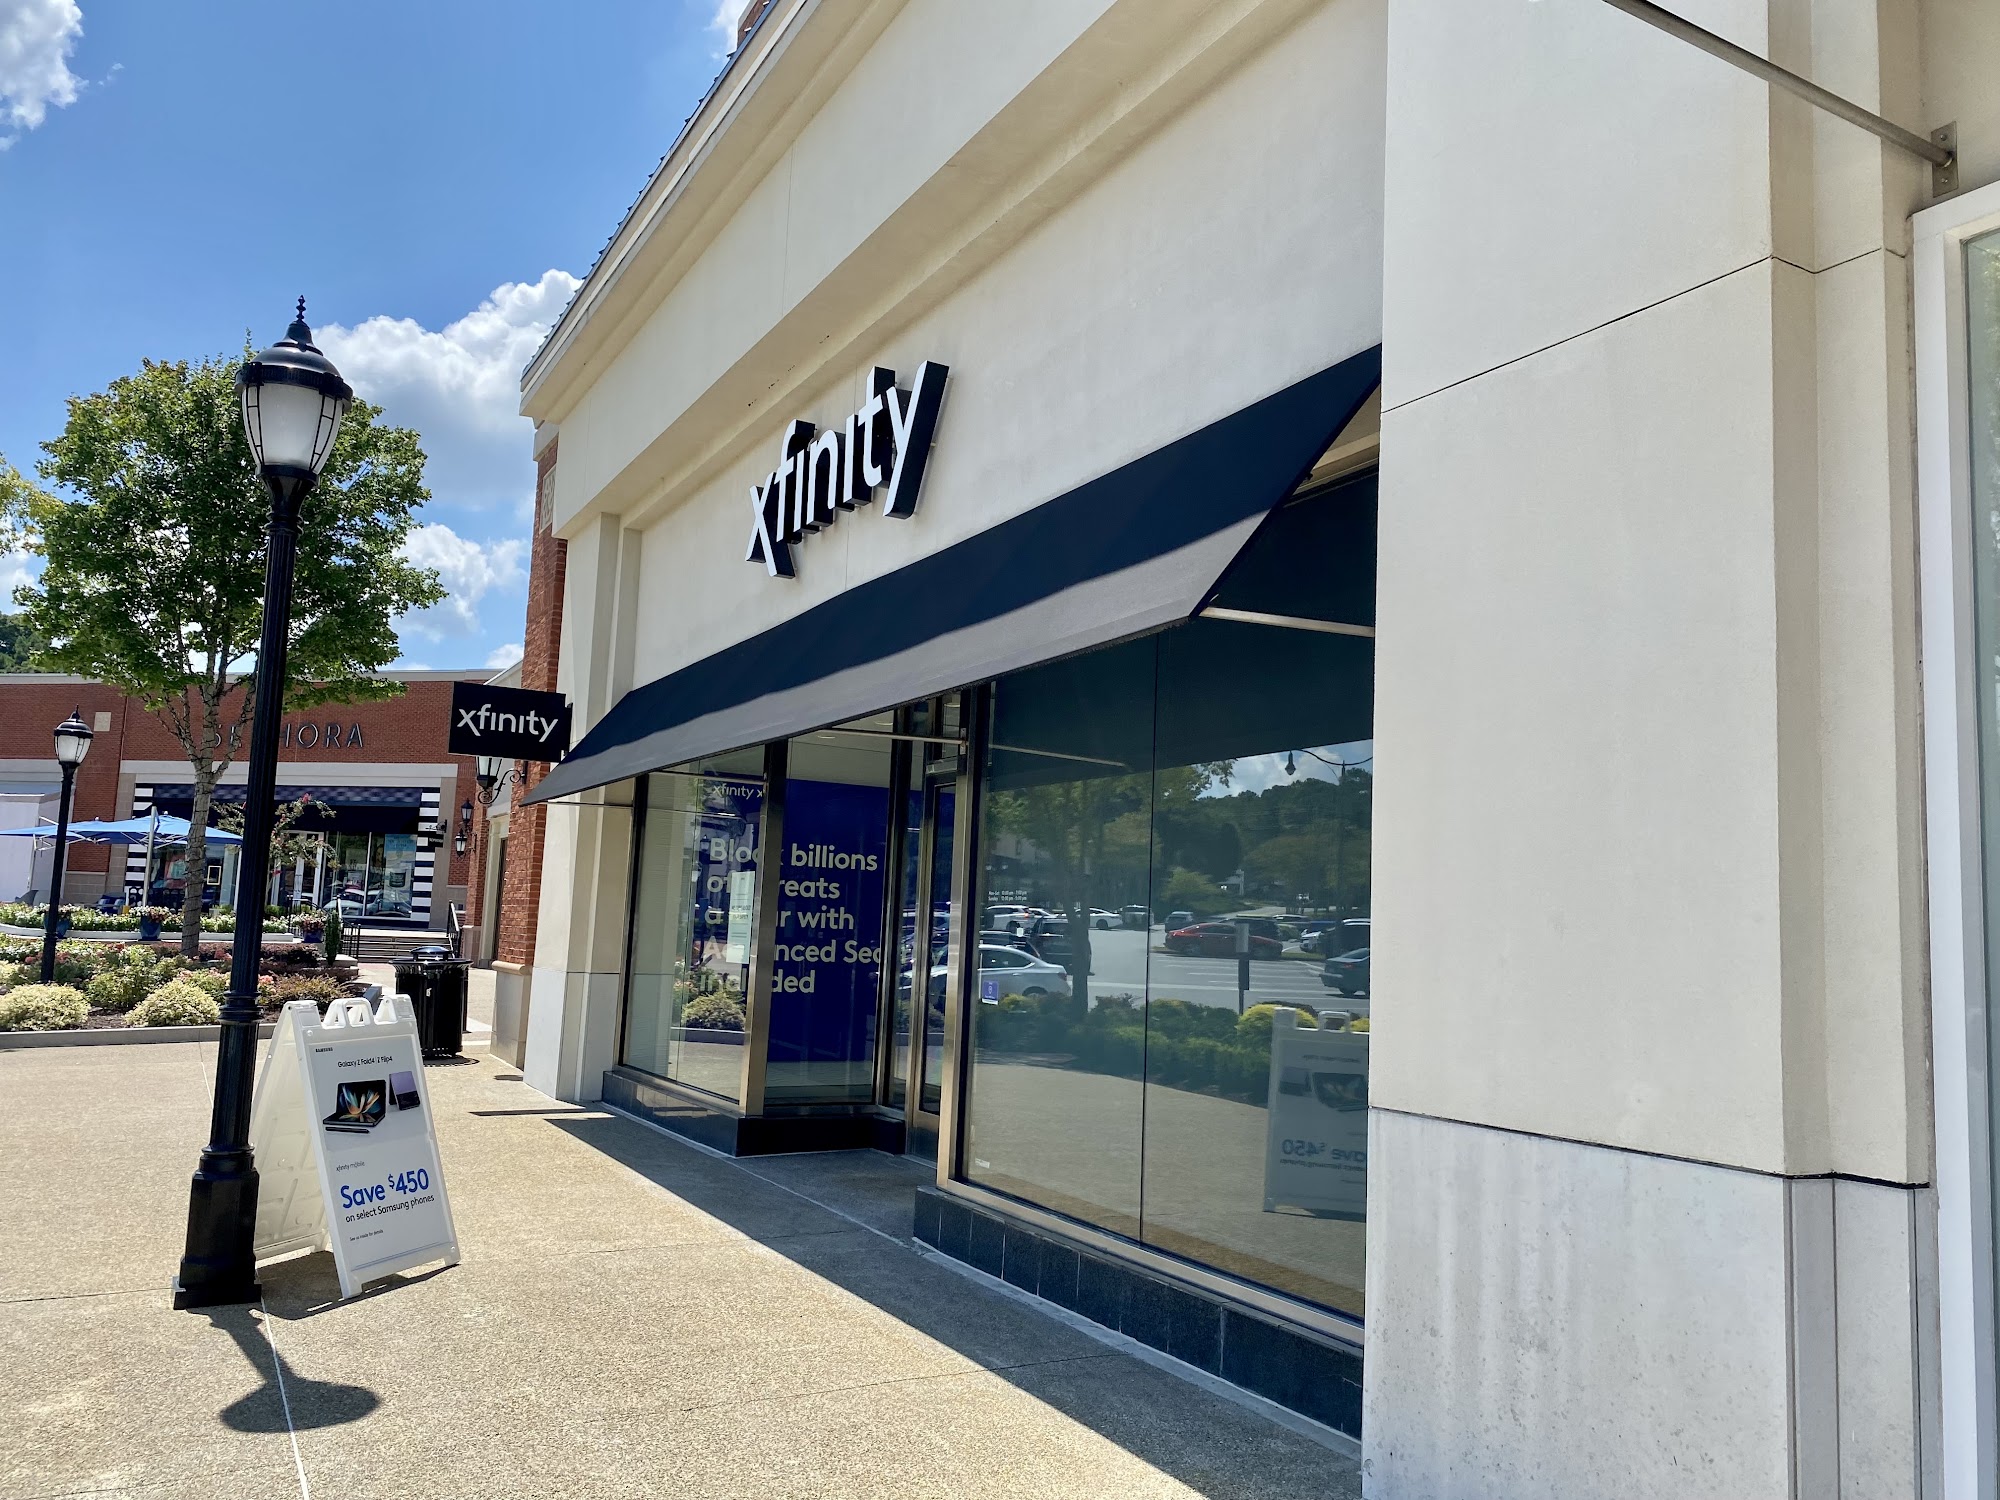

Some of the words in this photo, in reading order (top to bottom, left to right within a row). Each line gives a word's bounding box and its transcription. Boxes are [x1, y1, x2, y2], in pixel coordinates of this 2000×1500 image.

[745, 360, 949, 579] xfinity
[210, 723, 363, 748] SEHORA
[457, 703, 559, 743] xfinity
[713, 783, 754, 800] xfinity
[710, 838, 784, 866] Bloc
[791, 843, 878, 871] billions
[704, 908, 723, 925] a
[798, 905, 854, 930] with
[702, 936, 837, 963] Anced
[338, 1060, 357, 1068] Galaxy
[360, 1057, 375, 1065] Fold4
[381, 1056, 393, 1064] Flip4
[340, 1185, 386, 1209] Save
[388, 1168, 429, 1195] $450
[345, 1215, 356, 1223] on
[356, 1208, 377, 1220] select
[377, 1200, 410, 1215] Samsung
[410, 1194, 435, 1209] phones
